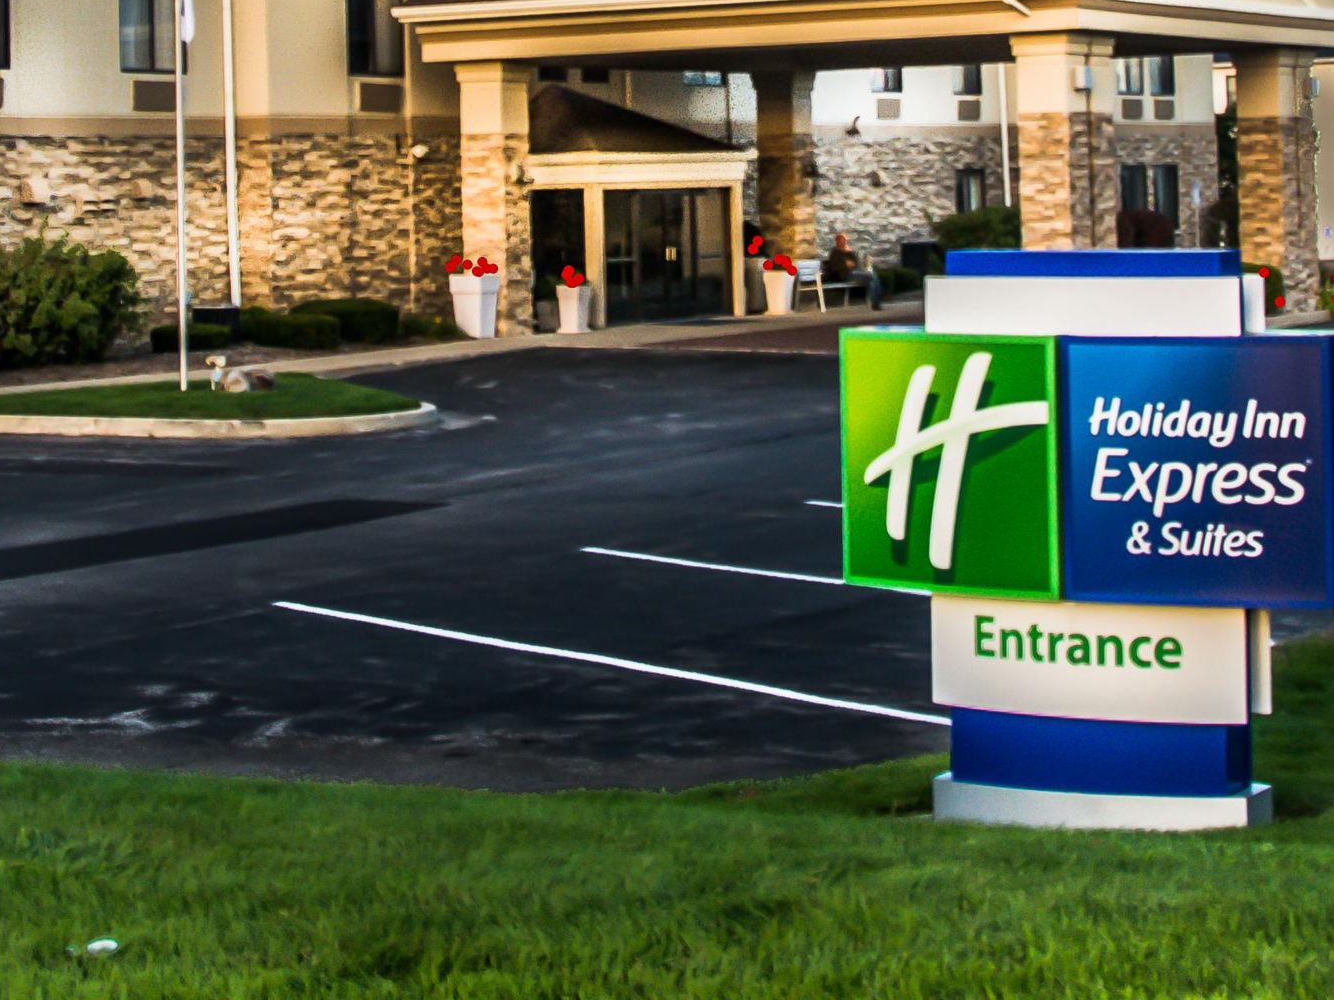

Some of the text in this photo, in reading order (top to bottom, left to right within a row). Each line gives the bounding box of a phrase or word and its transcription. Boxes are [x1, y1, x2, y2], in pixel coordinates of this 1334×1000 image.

[1088, 396, 1306, 448] Holiday Inn
[864, 351, 1048, 570] H
[1090, 447, 1307, 518] Express
[1126, 520, 1264, 558] & Suites
[974, 614, 1183, 669] Entrance
